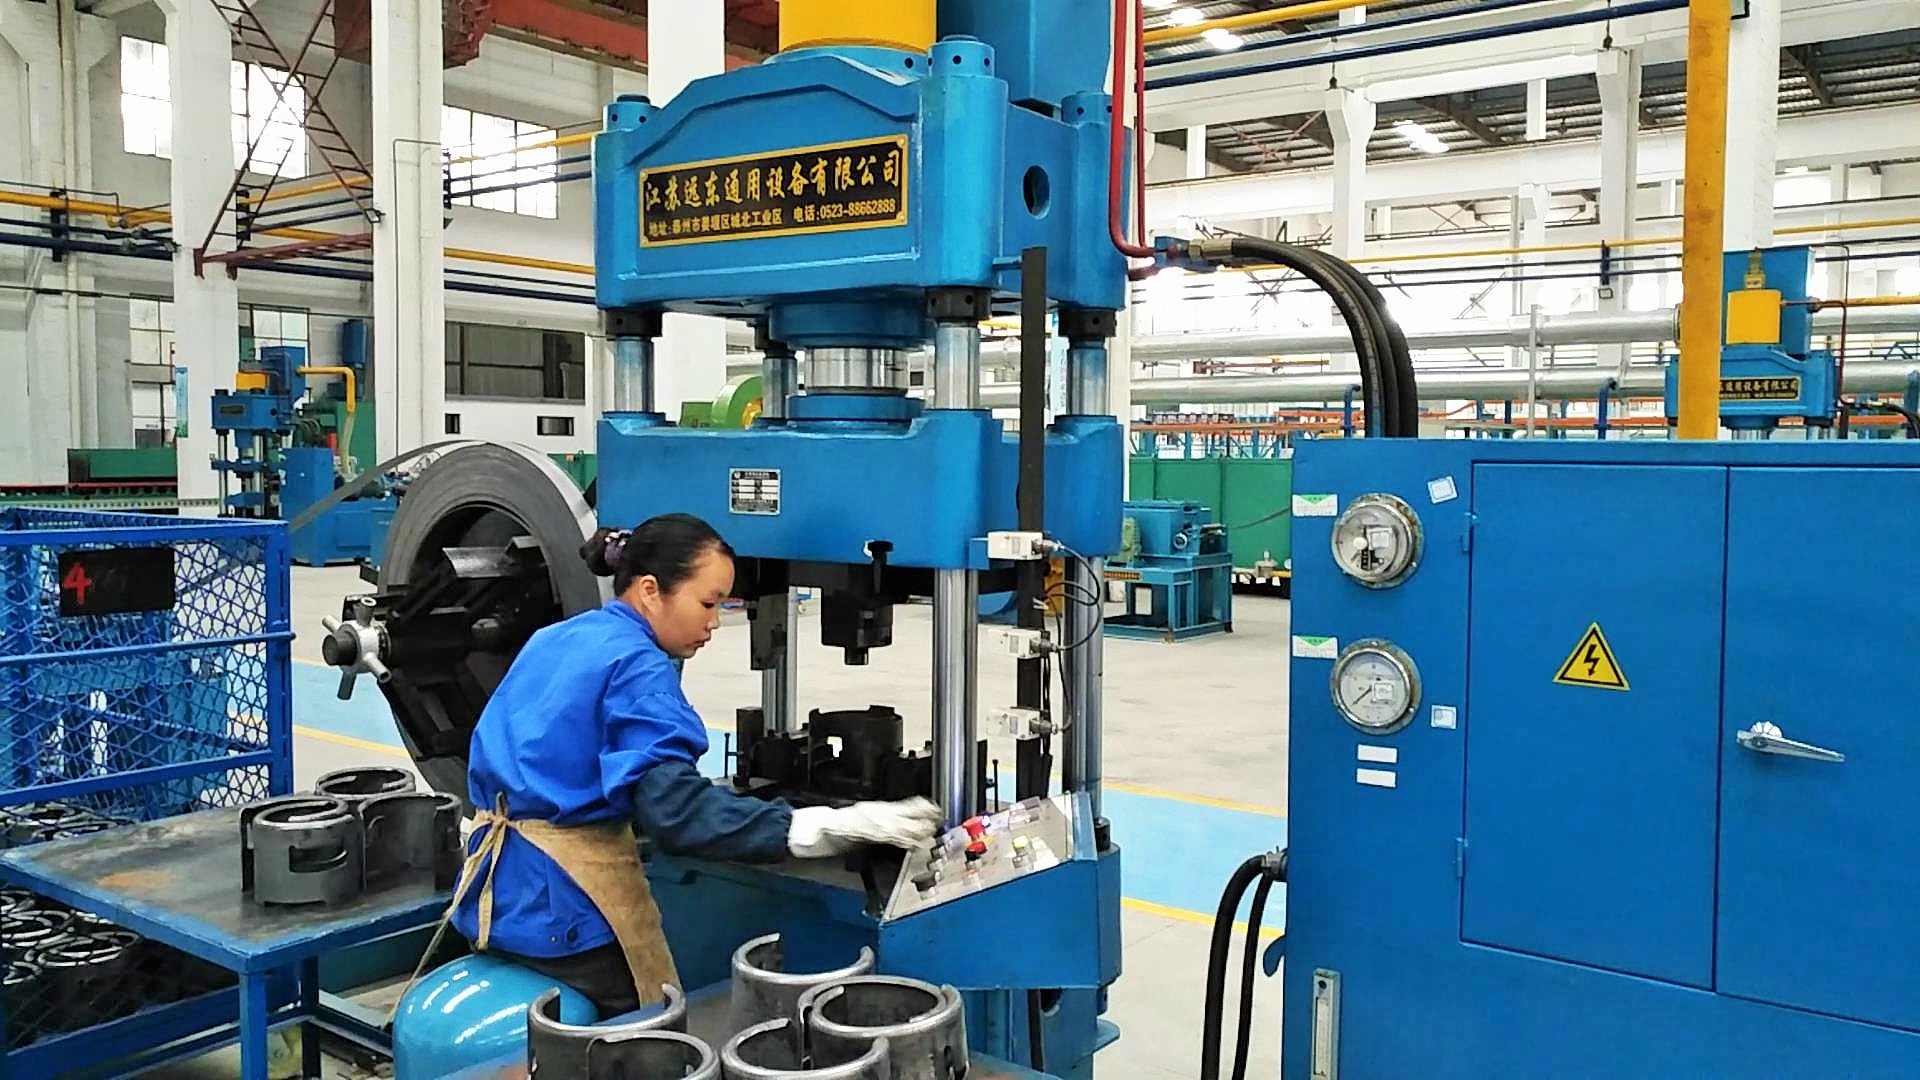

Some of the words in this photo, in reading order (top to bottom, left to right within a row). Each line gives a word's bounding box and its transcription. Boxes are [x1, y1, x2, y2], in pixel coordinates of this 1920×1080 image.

[645, 150, 900, 212] 江苏远东通用设备有限公司
[63, 562, 92, 606] 4
